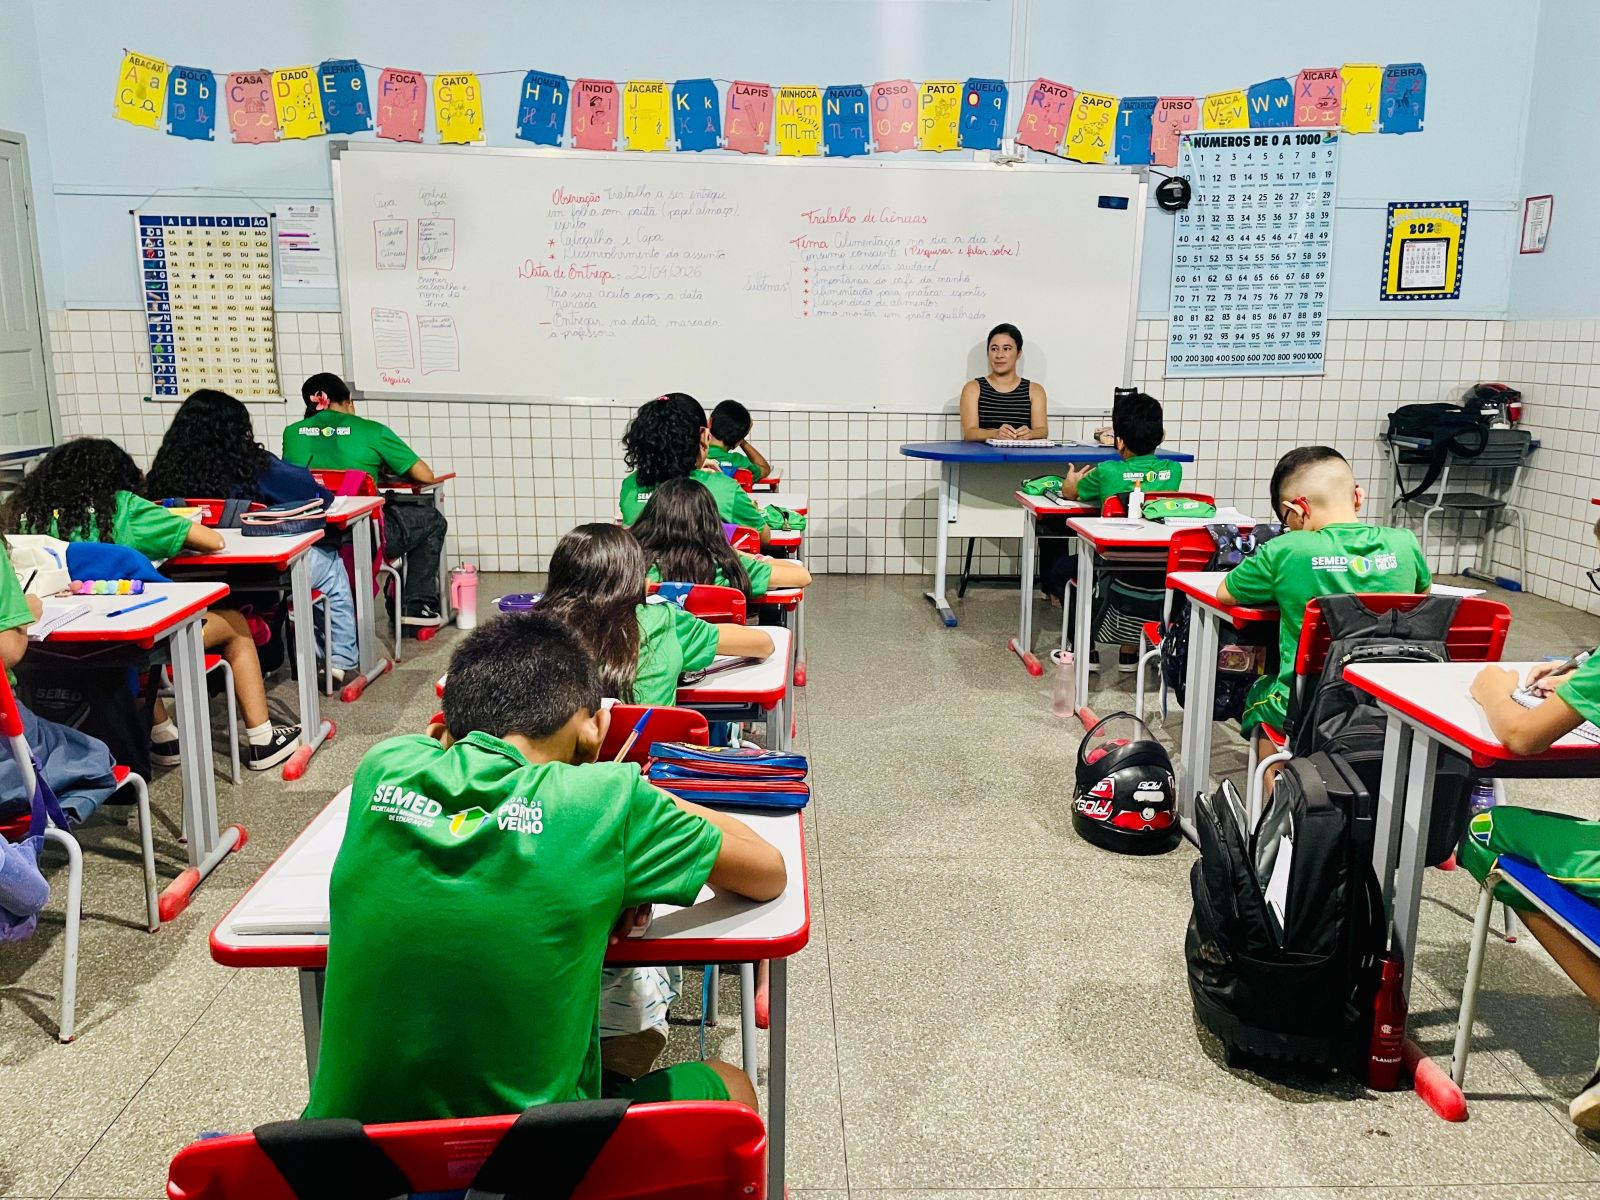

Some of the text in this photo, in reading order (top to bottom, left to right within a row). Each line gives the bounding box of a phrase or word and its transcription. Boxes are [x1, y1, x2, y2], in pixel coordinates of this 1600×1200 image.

[322, 64, 360, 74] ELEFANTE
[180, 71, 208, 82] BOLO
[236, 76, 263, 85] CASA
[280, 71, 308, 80] DADO
[389, 73, 417, 84] FOCA
[1386, 72, 1424, 83] ZEBRA
[323, 74, 362, 93] E e
[441, 77, 469, 86] GATO
[174, 78, 210, 99] B b
[525, 82, 563, 105] H h
[780, 89, 818, 98] MINHOCA
[829, 88, 863, 98] NAVIO
[877, 86, 908, 96] OSSO
[927, 86, 955, 94] PATO
[969, 83, 1004, 93] QUEIJO
[1039, 83, 1068, 99] RATO
[826, 98, 865, 116] N n
[1081, 96, 1112, 109] SAPO
[1161, 101, 1193, 110] URSO
[1210, 96, 1240, 107] VACA
[1250, 94, 1270, 114] W
[1194, 133, 1321, 149] NÚMEROS DE 0 A 1000
[168, 217, 175, 225] A
[221, 218, 228, 226] O
[800, 207, 858, 225] Trabalho
[788, 234, 829, 249] Tema
[518, 259, 550, 280] Data
[1311, 557, 1348, 566] SEMED
[373, 785, 442, 817] SEMED
[497, 816, 544, 834] VELHO
